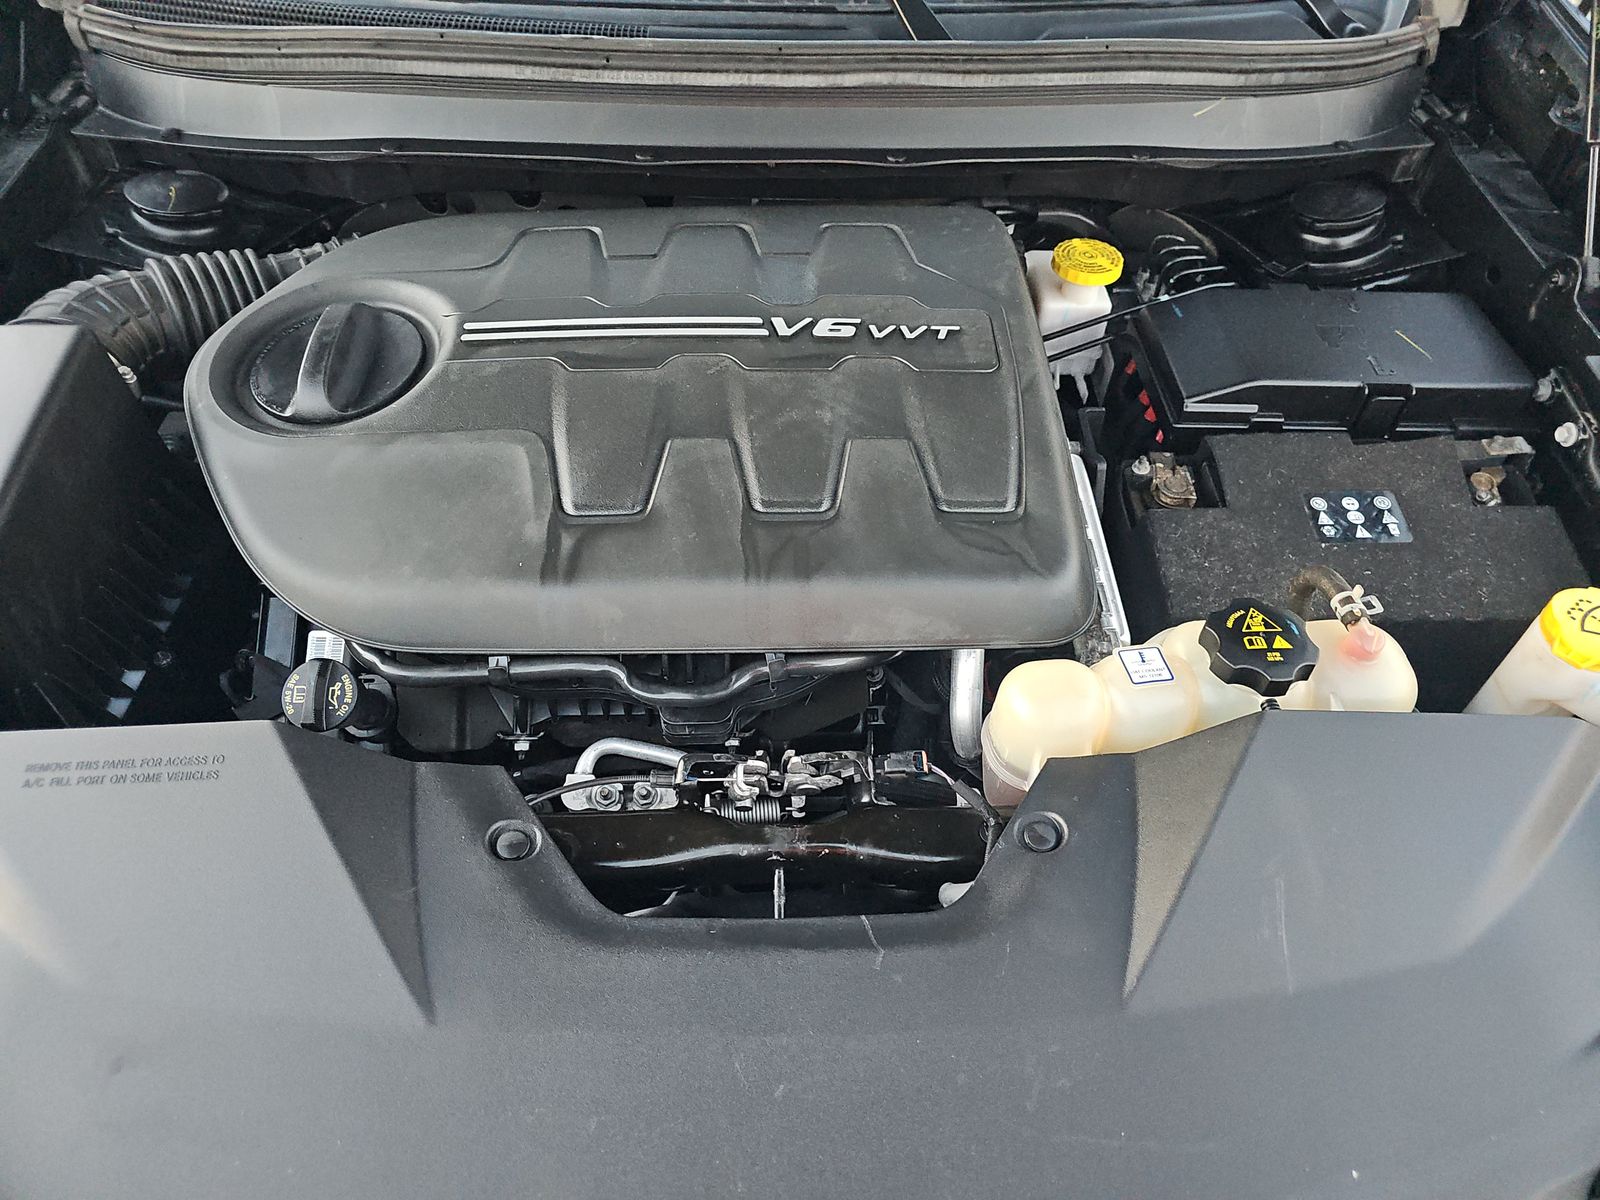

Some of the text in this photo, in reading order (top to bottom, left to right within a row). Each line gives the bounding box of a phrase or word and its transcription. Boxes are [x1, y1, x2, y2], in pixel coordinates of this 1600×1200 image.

[770, 316, 961, 341] V6 VVT
[284, 673, 300, 715] SAE 5W-20
[336, 673, 353, 717] ENGINE OIL
[24, 754, 225, 773] REMOVE THIS PANEL FOR ACCESS TO
[21, 769, 220, 789] A/C FILL PORT ON SOME VEHICLES
